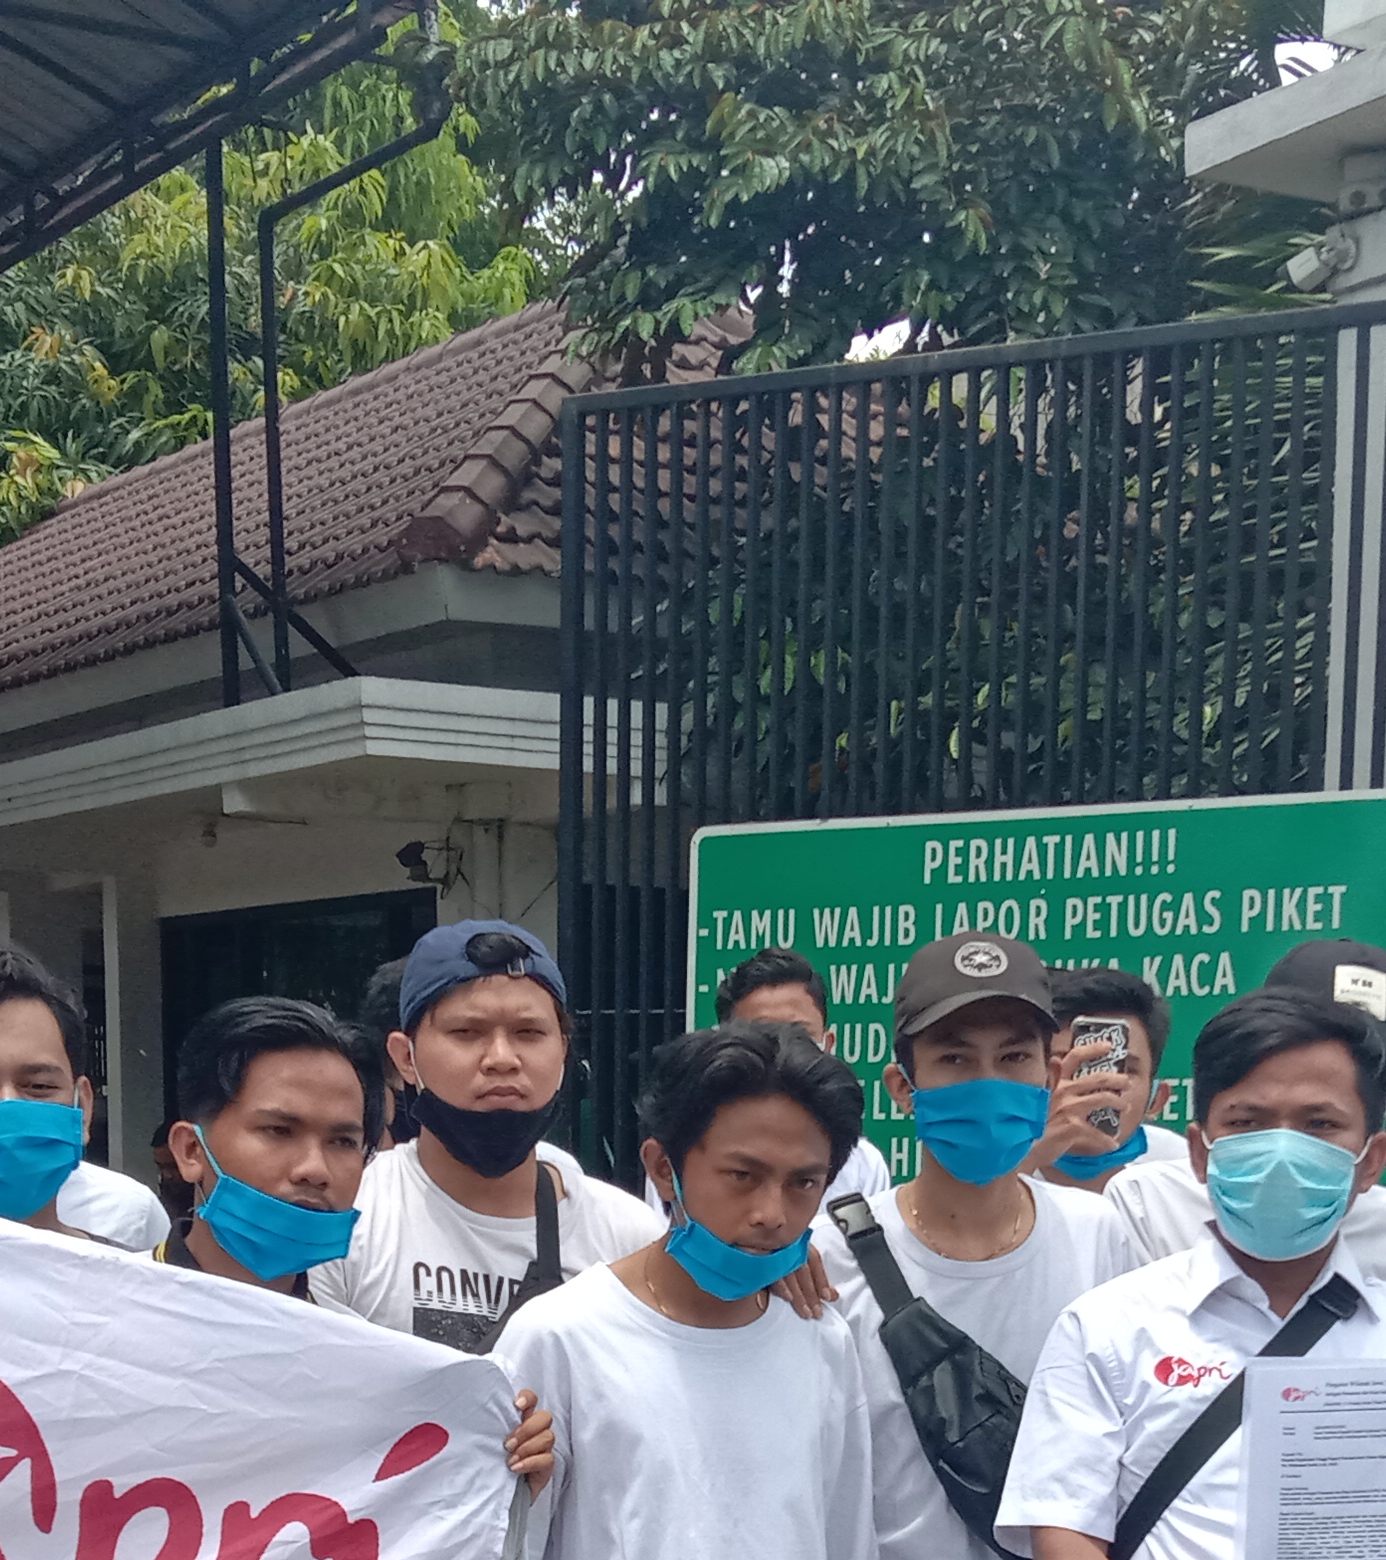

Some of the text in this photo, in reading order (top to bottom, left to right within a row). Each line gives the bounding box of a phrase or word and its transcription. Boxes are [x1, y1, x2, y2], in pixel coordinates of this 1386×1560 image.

[923, 828, 1177, 885] PERHATIAN!!!
[813, 904, 916, 948] WAJIB
[935, 897, 1048, 942] LAPOR
[1064, 889, 1222, 940] PETUGAS
[1240, 885, 1348, 933] PIKET
[829, 951, 1237, 1004] WAJ KACA
